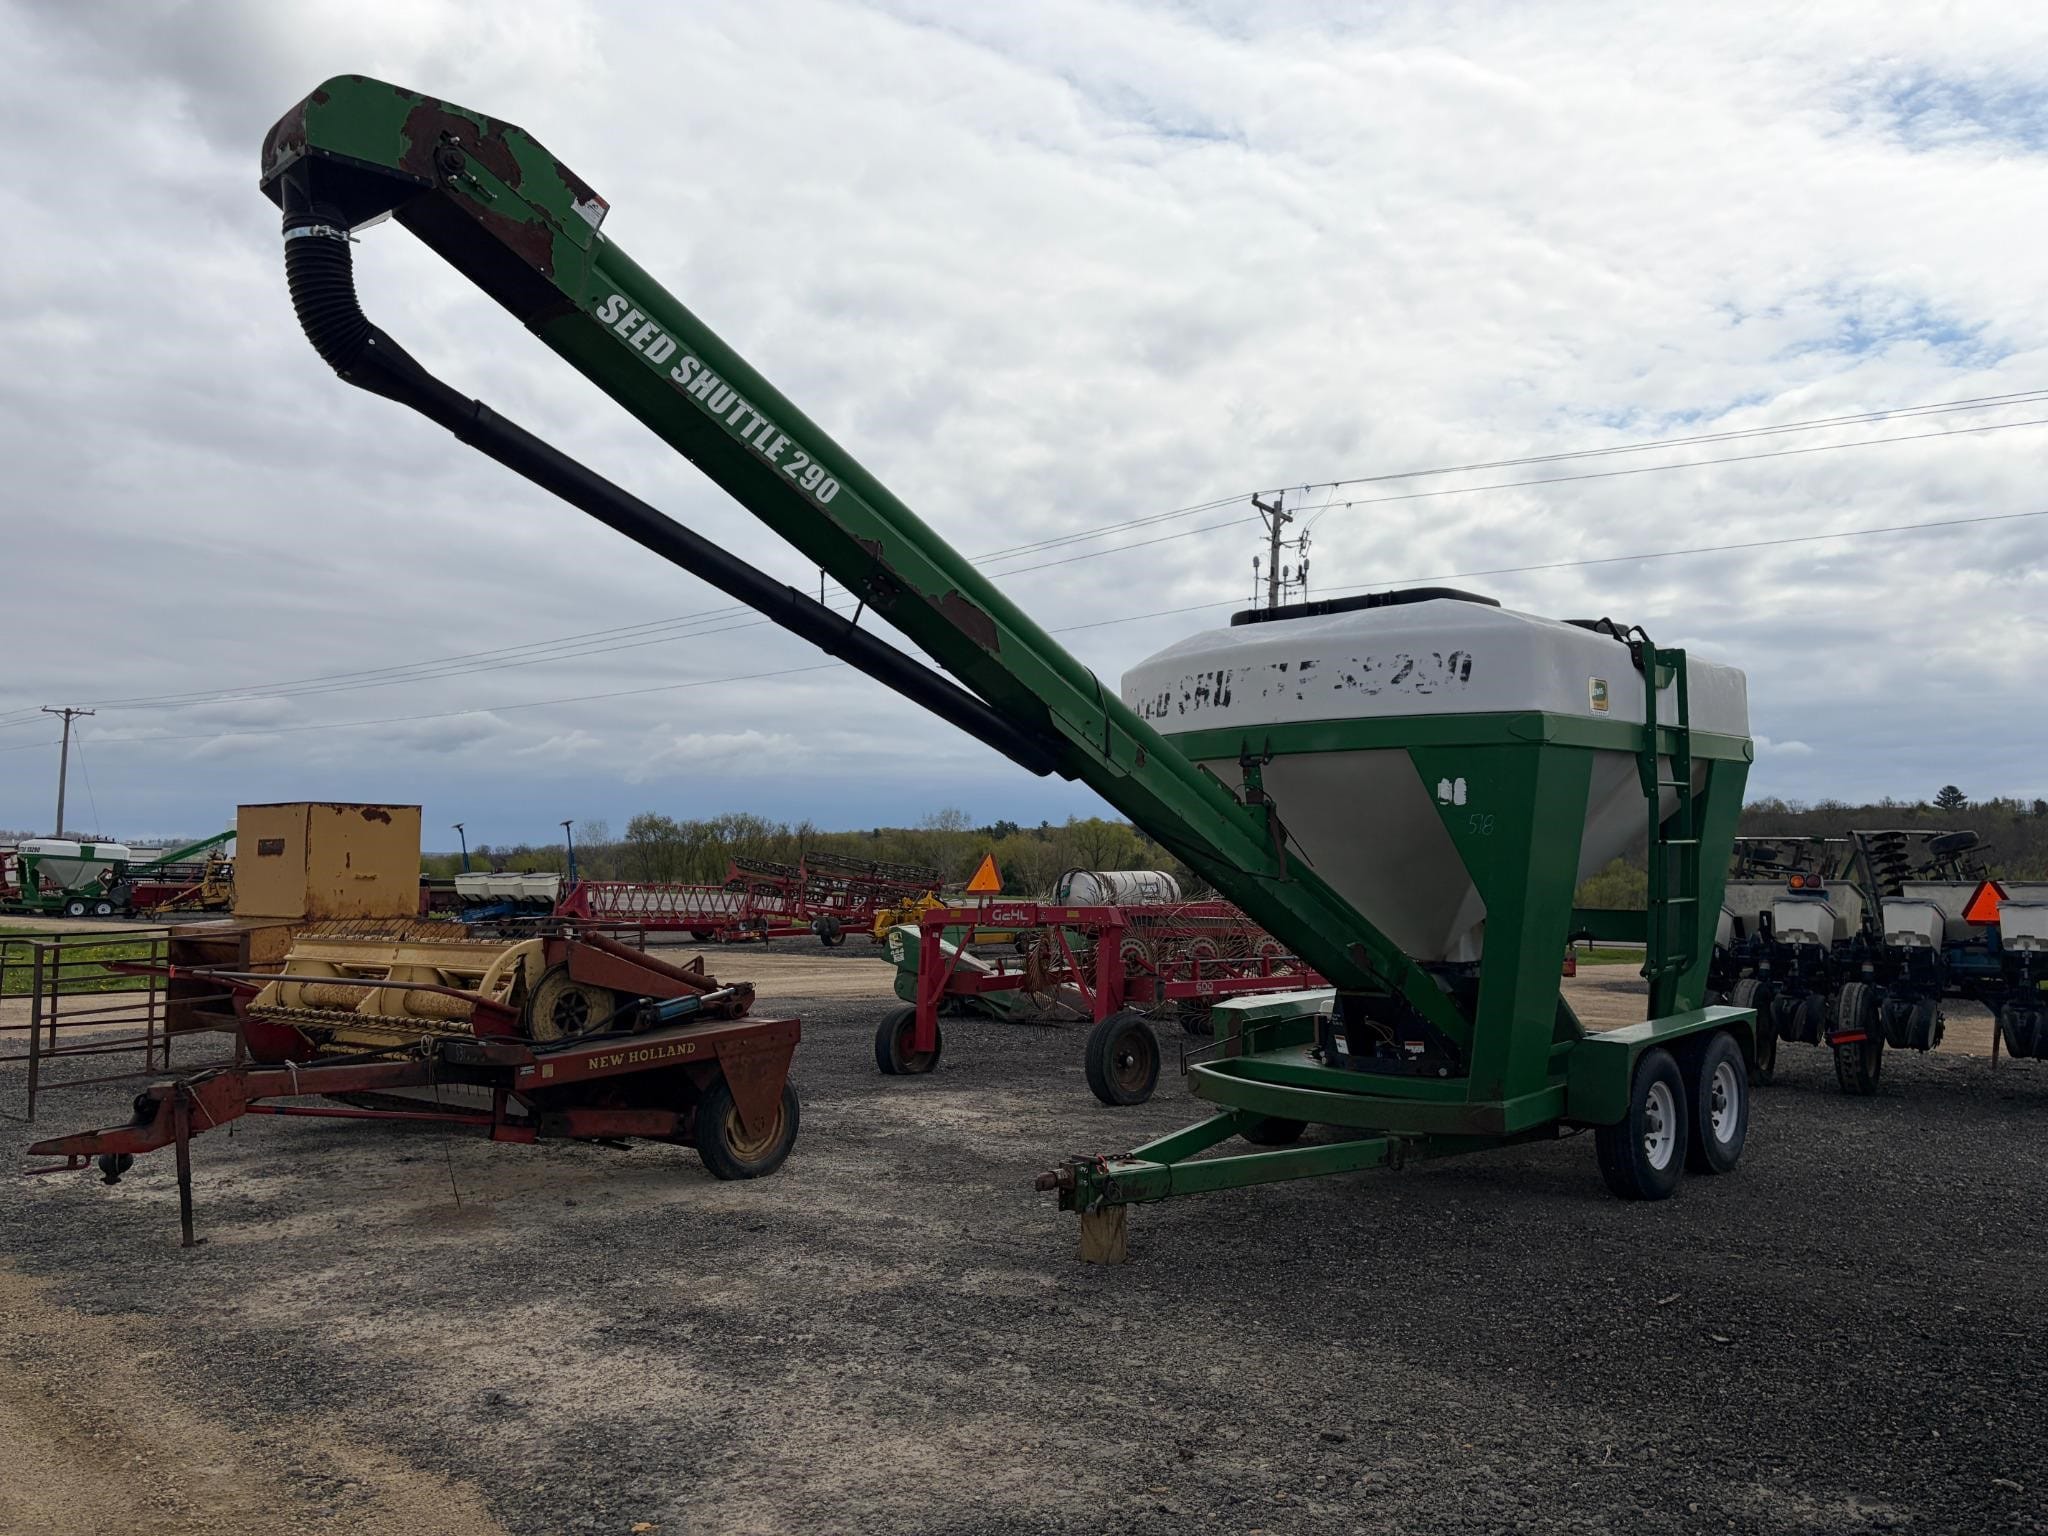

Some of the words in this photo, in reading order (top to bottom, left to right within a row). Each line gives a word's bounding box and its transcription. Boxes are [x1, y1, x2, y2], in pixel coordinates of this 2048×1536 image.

[596, 294, 677, 365] SEED
[670, 355, 792, 462] SHUTTLE
[782, 450, 840, 504] 290
[588, 1053, 625, 1070] NEW
[628, 1042, 696, 1063] HOLLAND
